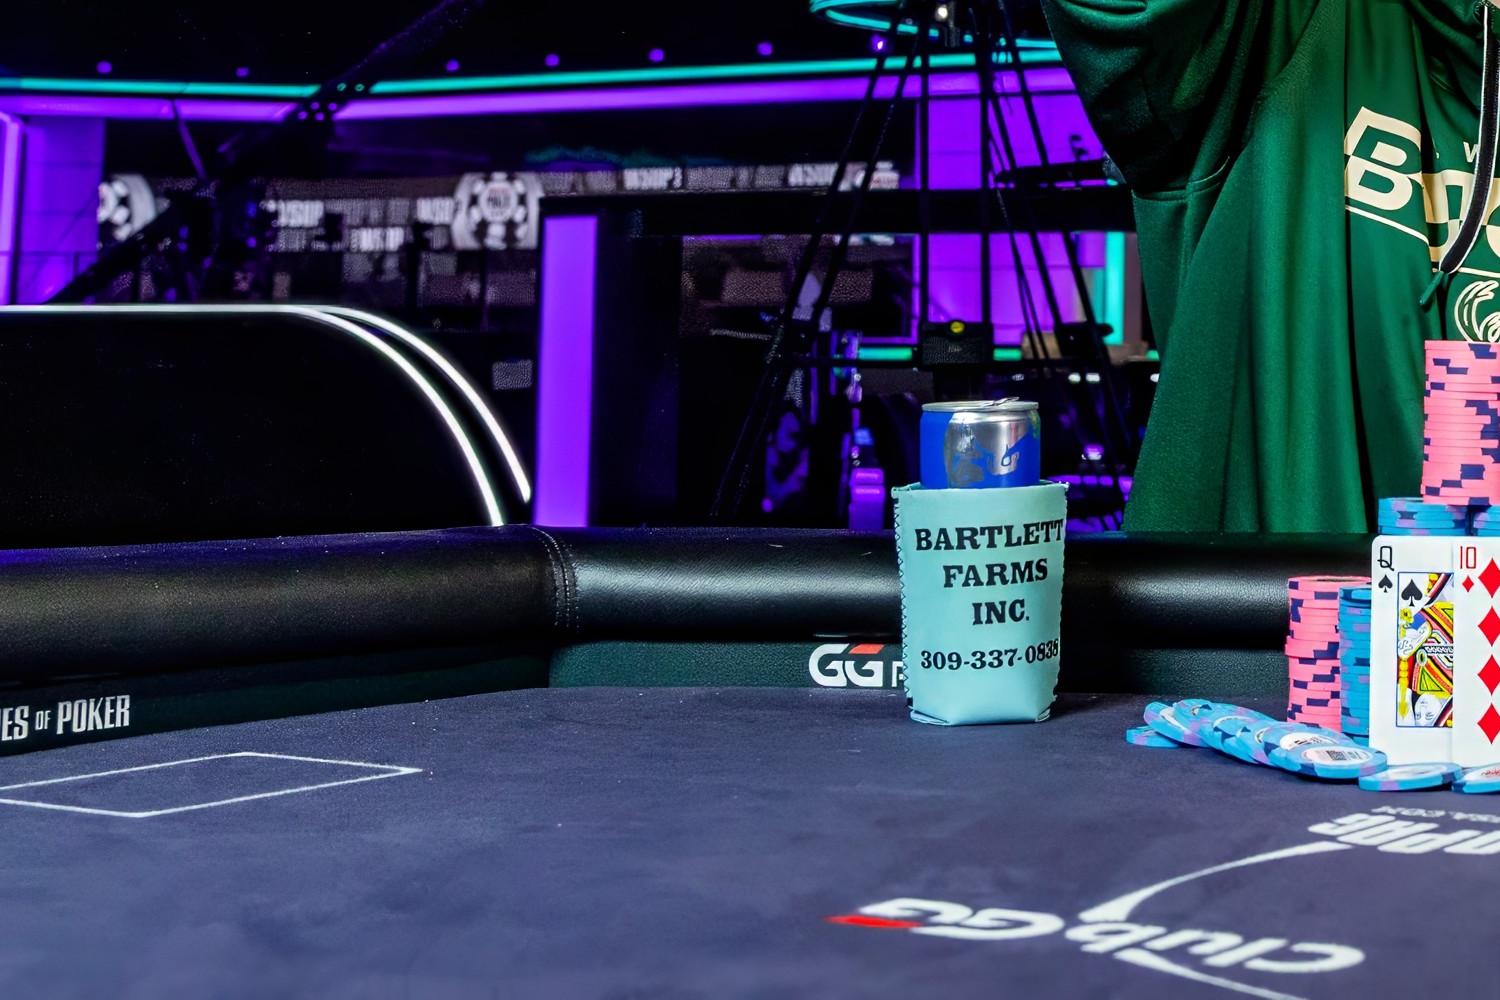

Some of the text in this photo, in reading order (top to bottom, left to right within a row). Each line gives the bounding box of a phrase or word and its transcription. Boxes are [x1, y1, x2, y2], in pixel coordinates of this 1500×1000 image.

[915, 518, 1064, 551] BARTLETT
[1378, 546, 1394, 571] Q
[1460, 546, 1477, 569] 10
[943, 558, 1048, 588] FARMS
[972, 599, 1030, 626] INC.
[0, 694, 131, 742] ES OF POKER
